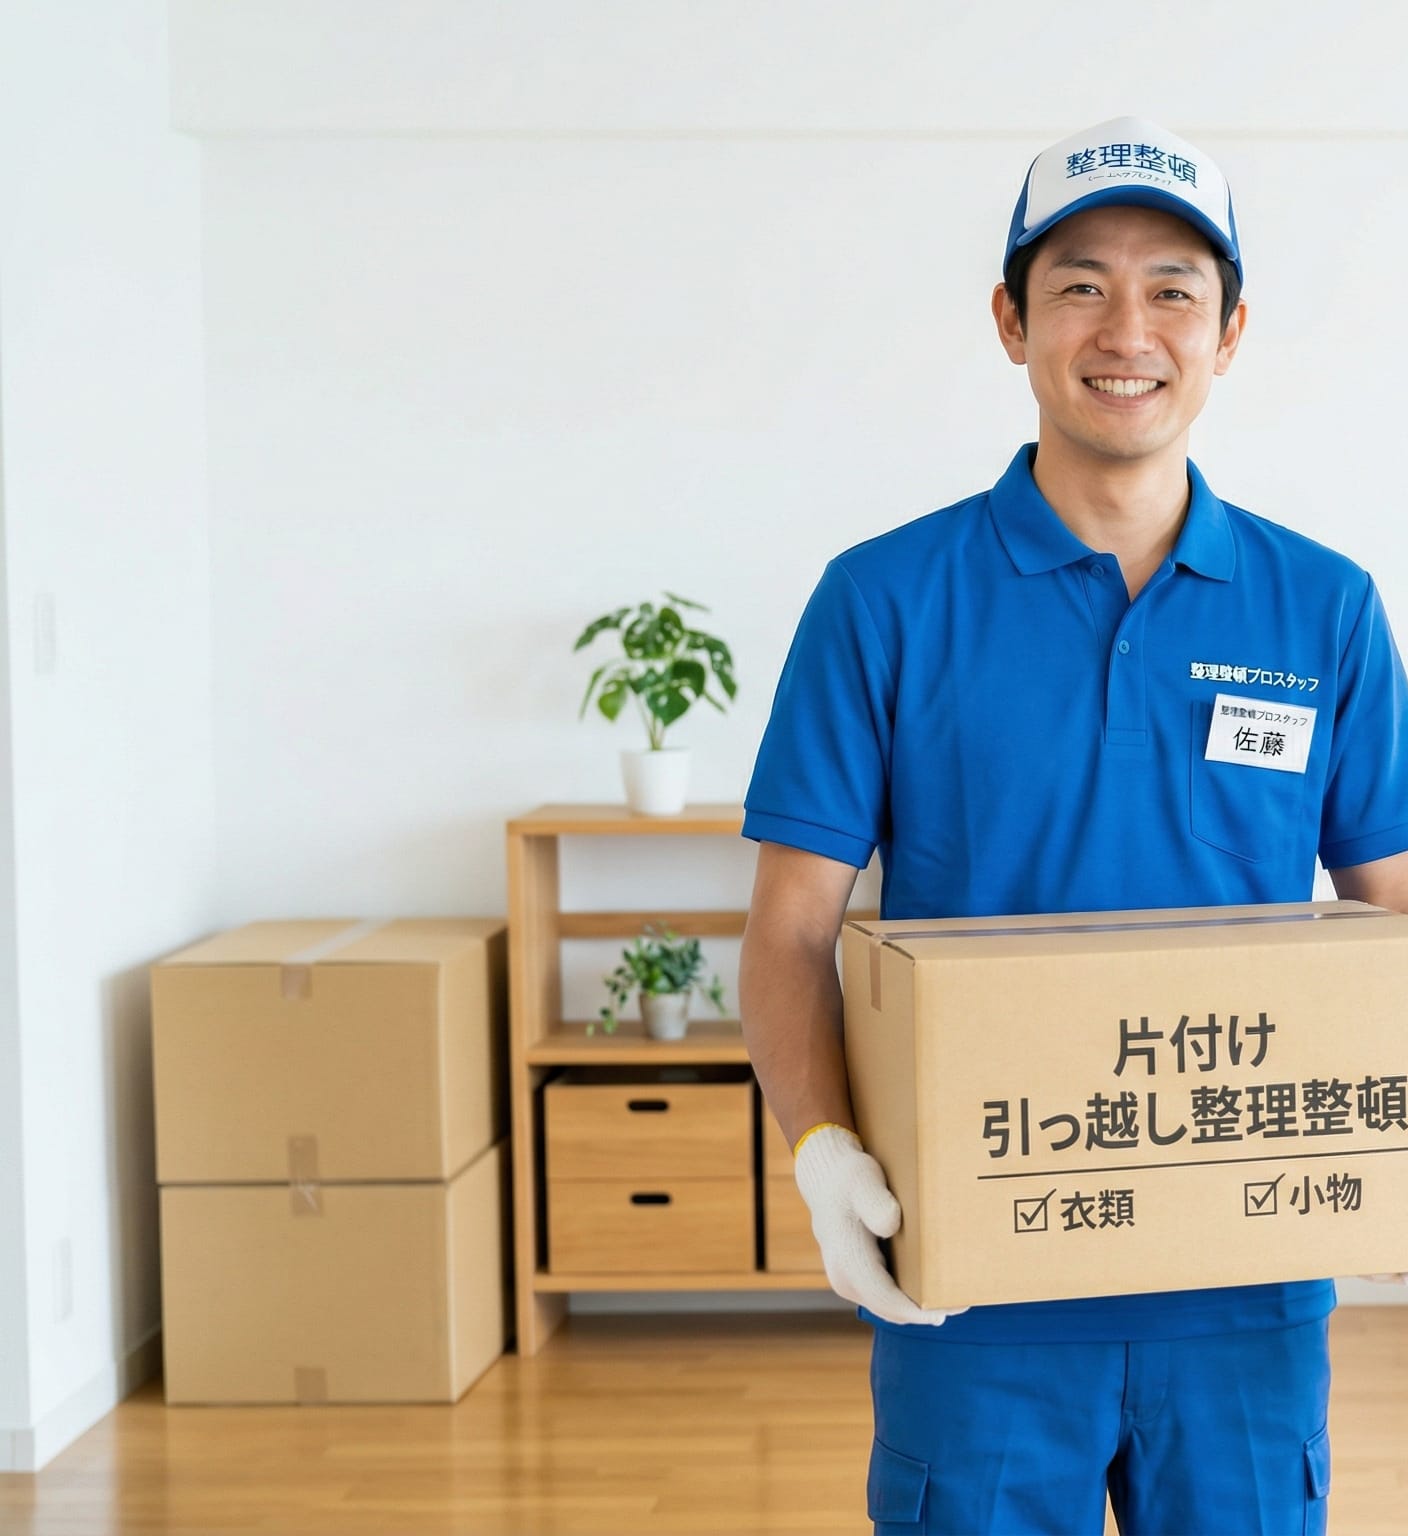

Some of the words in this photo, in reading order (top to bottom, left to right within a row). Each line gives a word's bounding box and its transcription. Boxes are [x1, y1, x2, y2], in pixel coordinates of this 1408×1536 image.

[1066, 143, 1198, 189] 整理整頓
[1232, 726, 1286, 757] 佐藤
[1113, 1012, 1276, 1076] 片付け
[982, 1075, 1408, 1158] 引っ越し整理整頓
[1060, 1189, 1136, 1231] 衣類
[1289, 1173, 1363, 1214] 小物
